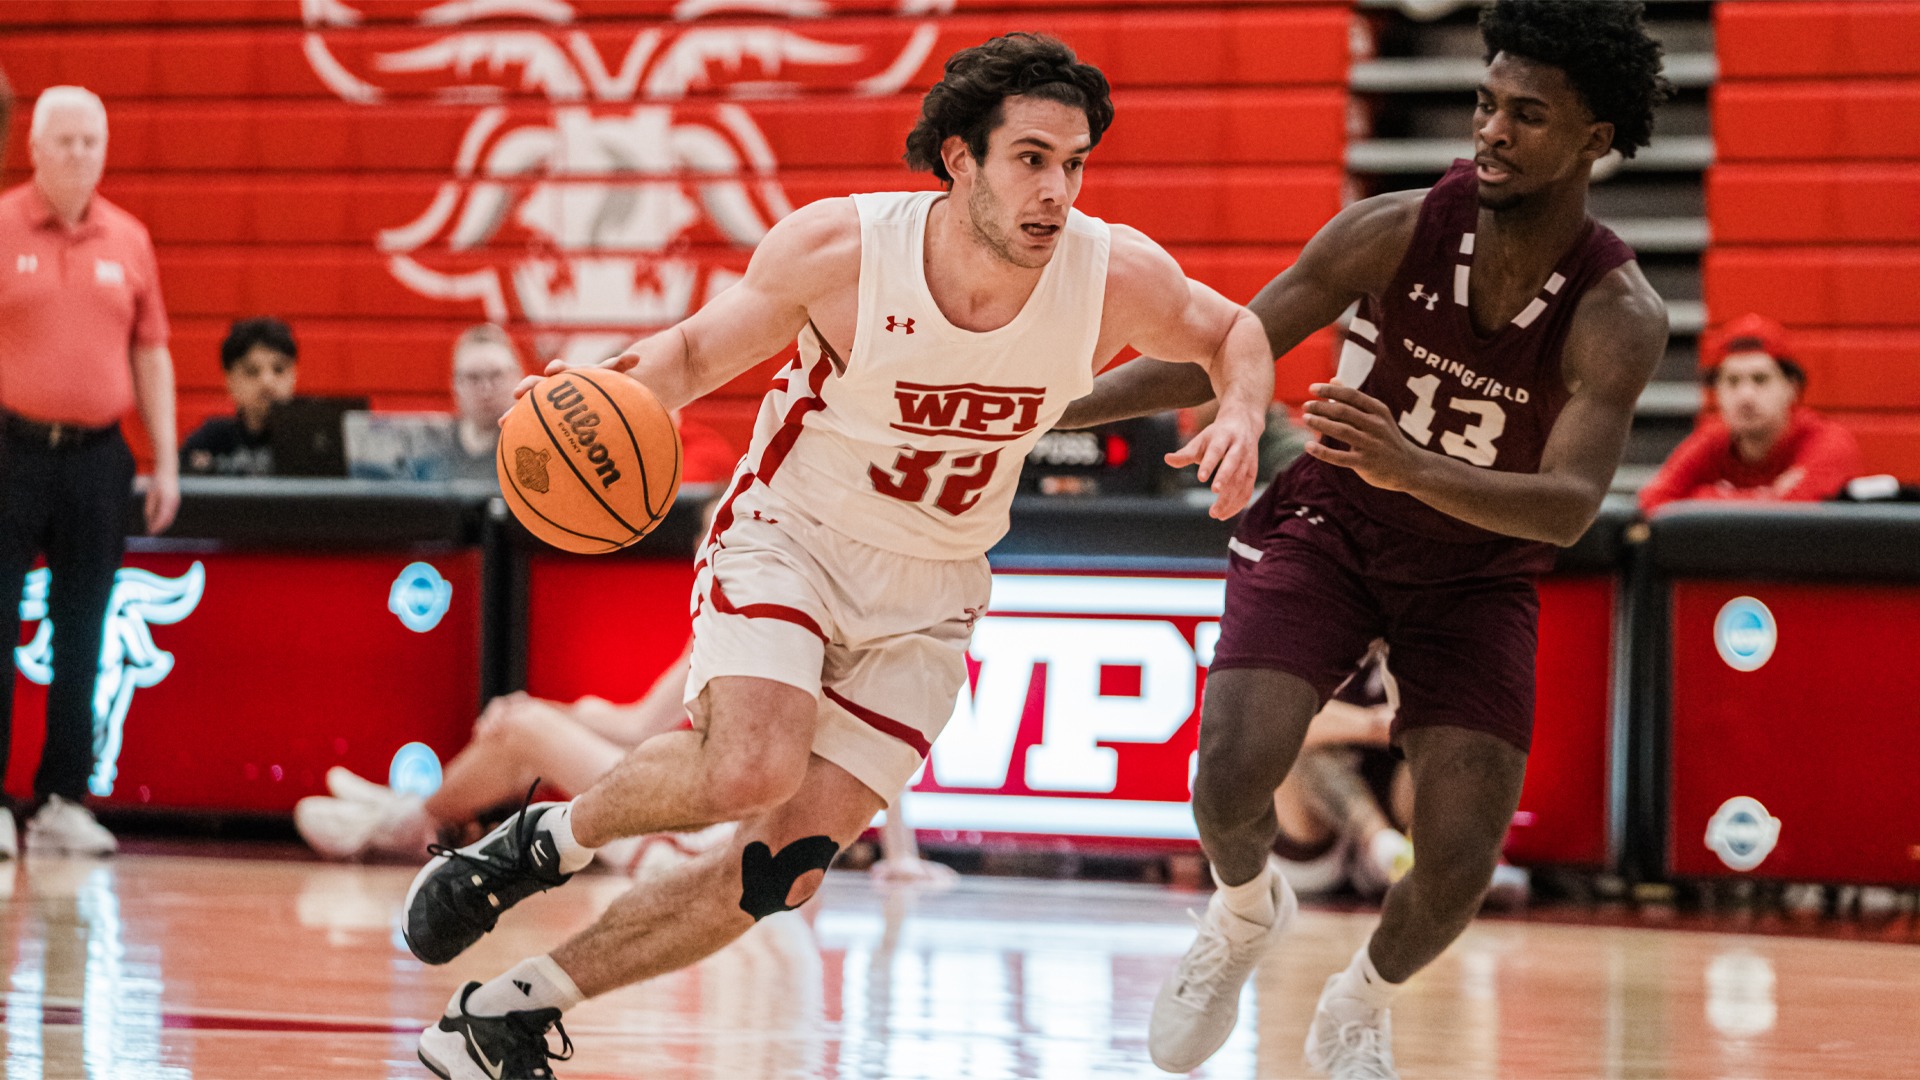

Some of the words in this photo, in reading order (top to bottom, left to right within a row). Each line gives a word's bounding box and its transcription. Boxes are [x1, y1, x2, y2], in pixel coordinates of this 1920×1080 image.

[893, 389, 1046, 433] WPI
[1403, 338, 1530, 404] SPRINGFIELD
[546, 380, 621, 489] Wilson
[1398, 373, 1507, 467] 13
[866, 443, 1007, 517] 32
[903, 615, 1223, 794] WP
